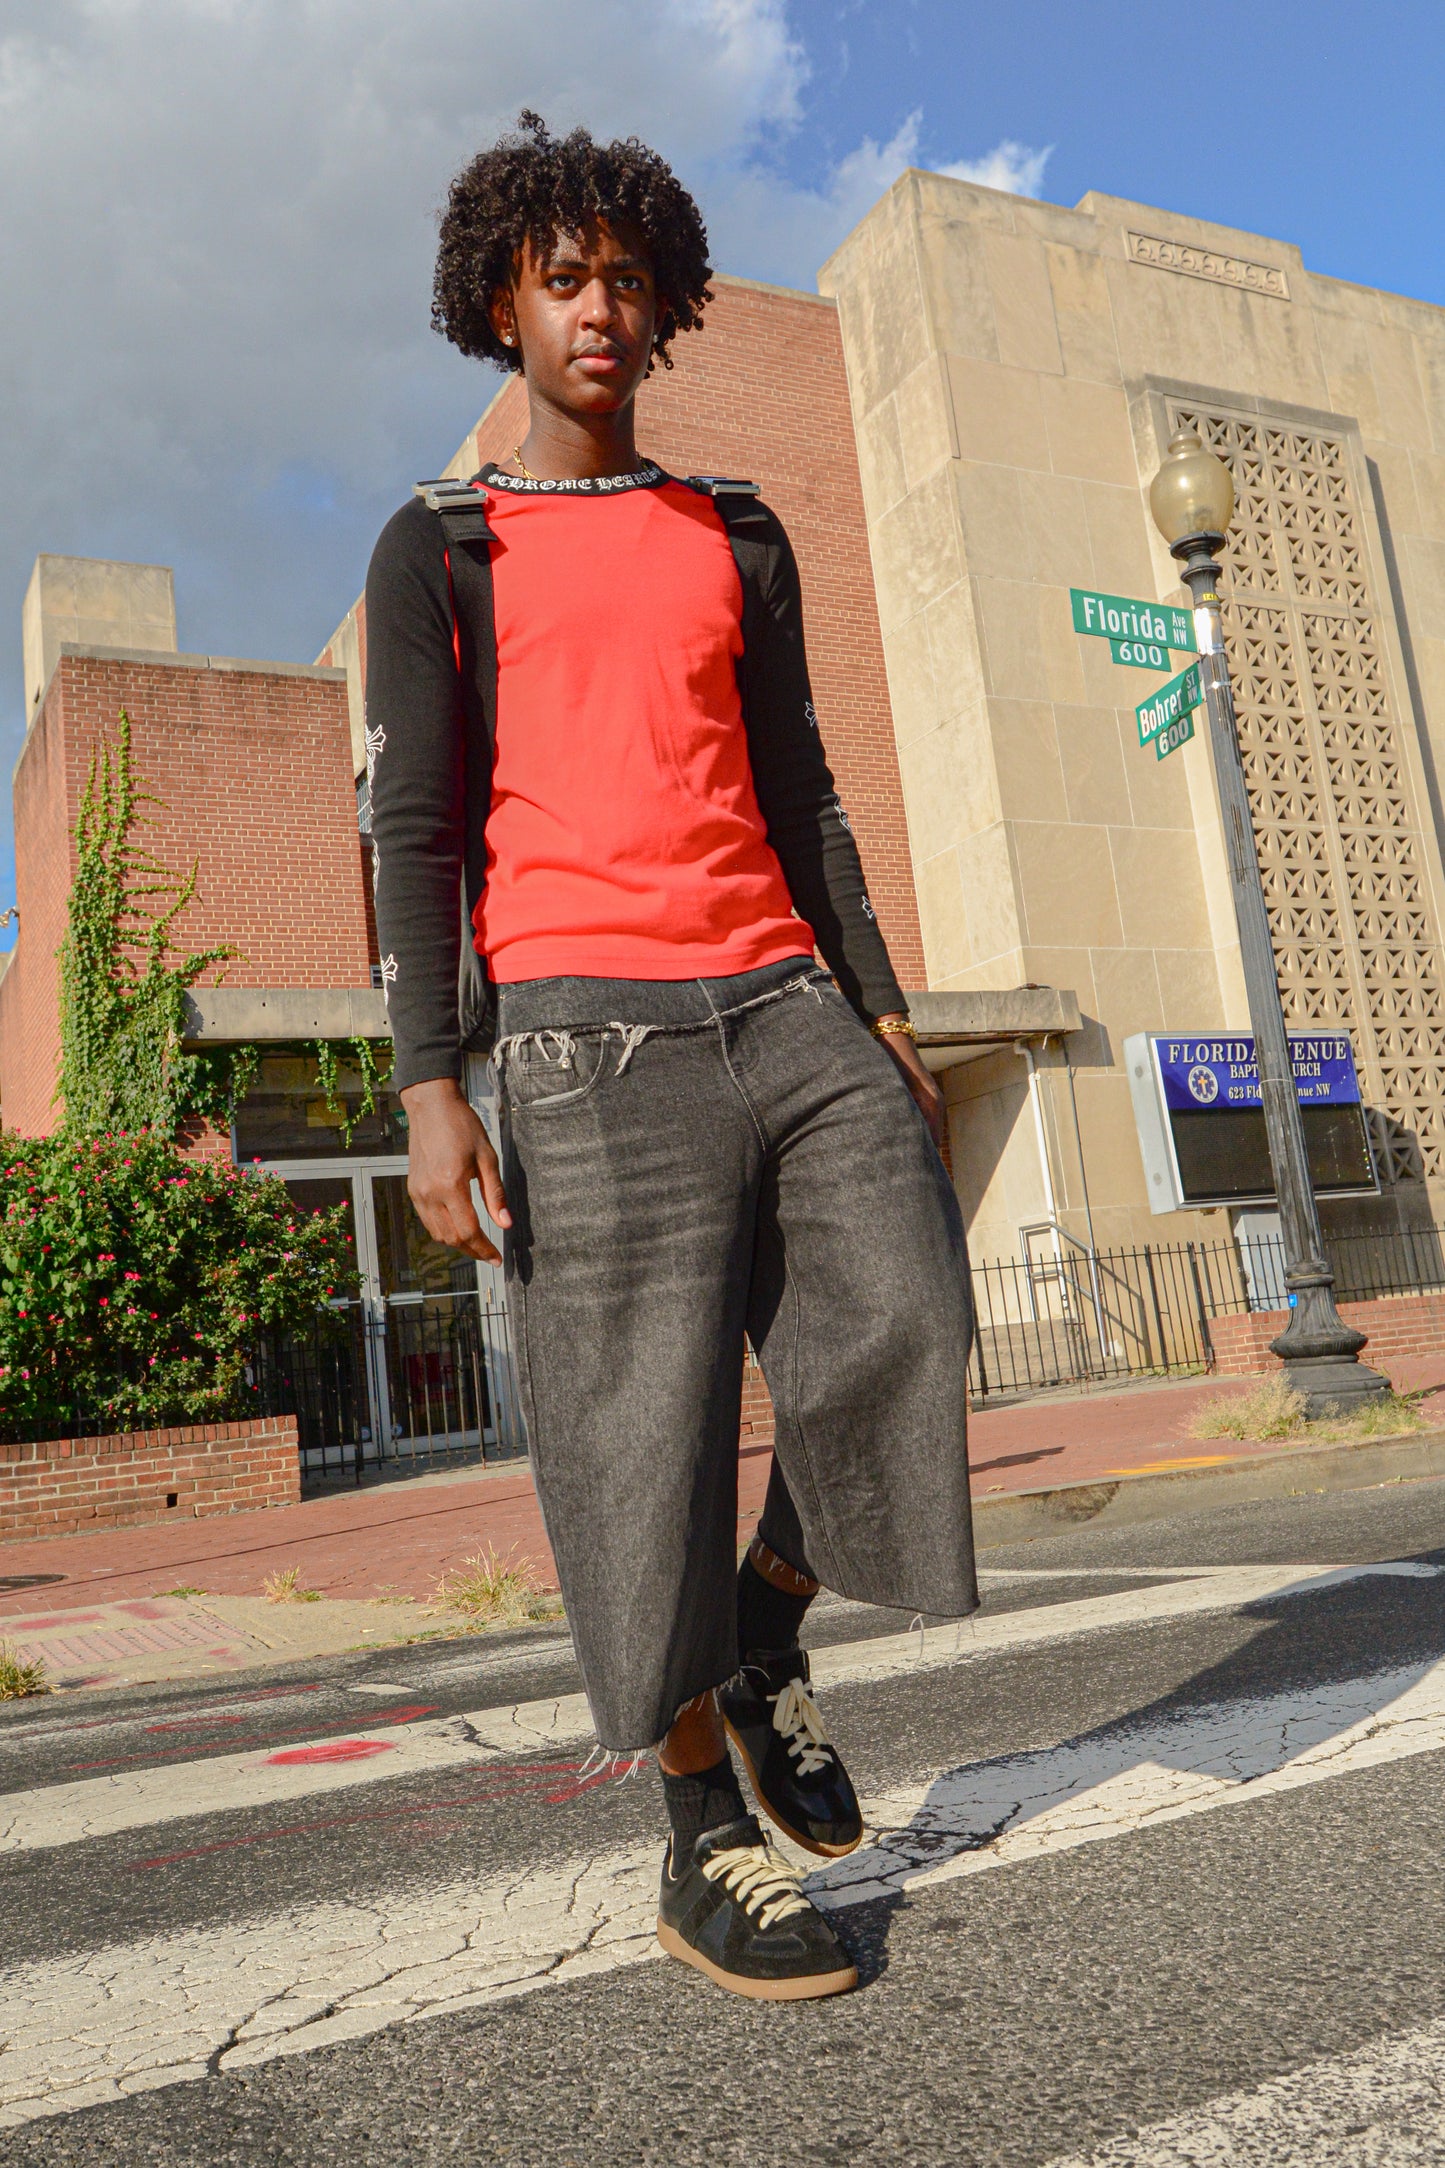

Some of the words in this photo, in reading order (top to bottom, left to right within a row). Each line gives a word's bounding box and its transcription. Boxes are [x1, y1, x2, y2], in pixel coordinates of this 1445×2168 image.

[498, 475, 592, 491] CHROME
[1083, 596, 1167, 641] Florida
[1172, 611, 1186, 628] Ave
[1173, 628, 1187, 645] NW
[1119, 641, 1163, 666] 600
[1186, 671, 1195, 689] ST
[1187, 685, 1198, 704] NW
[1139, 687, 1183, 739] Bohrer
[1158, 717, 1189, 754] 600
[1289, 1041, 1347, 1060] ENUE
[1230, 1064, 1259, 1079] BAPT
[1292, 1062, 1321, 1077] URCH
[1228, 1086, 1244, 1099] 623
[1297, 1087, 1314, 1097] nue
[1316, 1083, 1331, 1096] NW
